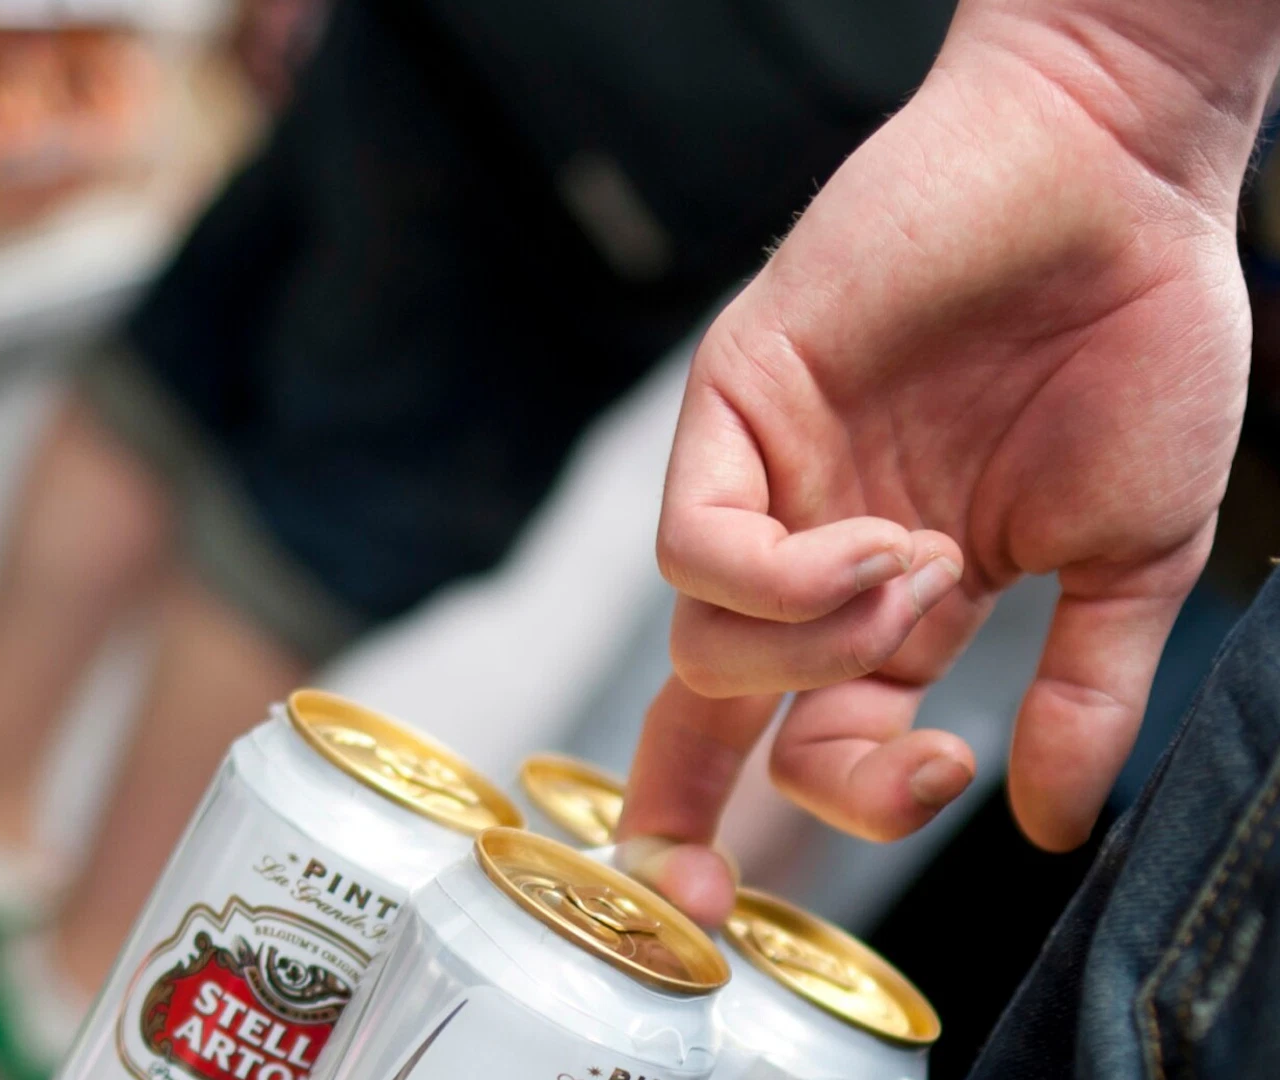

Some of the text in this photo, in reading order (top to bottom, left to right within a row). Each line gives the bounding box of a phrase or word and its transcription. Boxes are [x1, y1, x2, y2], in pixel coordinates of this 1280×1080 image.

[291, 877, 365, 932] Grande
[302, 858, 399, 919] PINT
[321, 949, 361, 984] ORIGIN
[193, 981, 312, 1069] STELL
